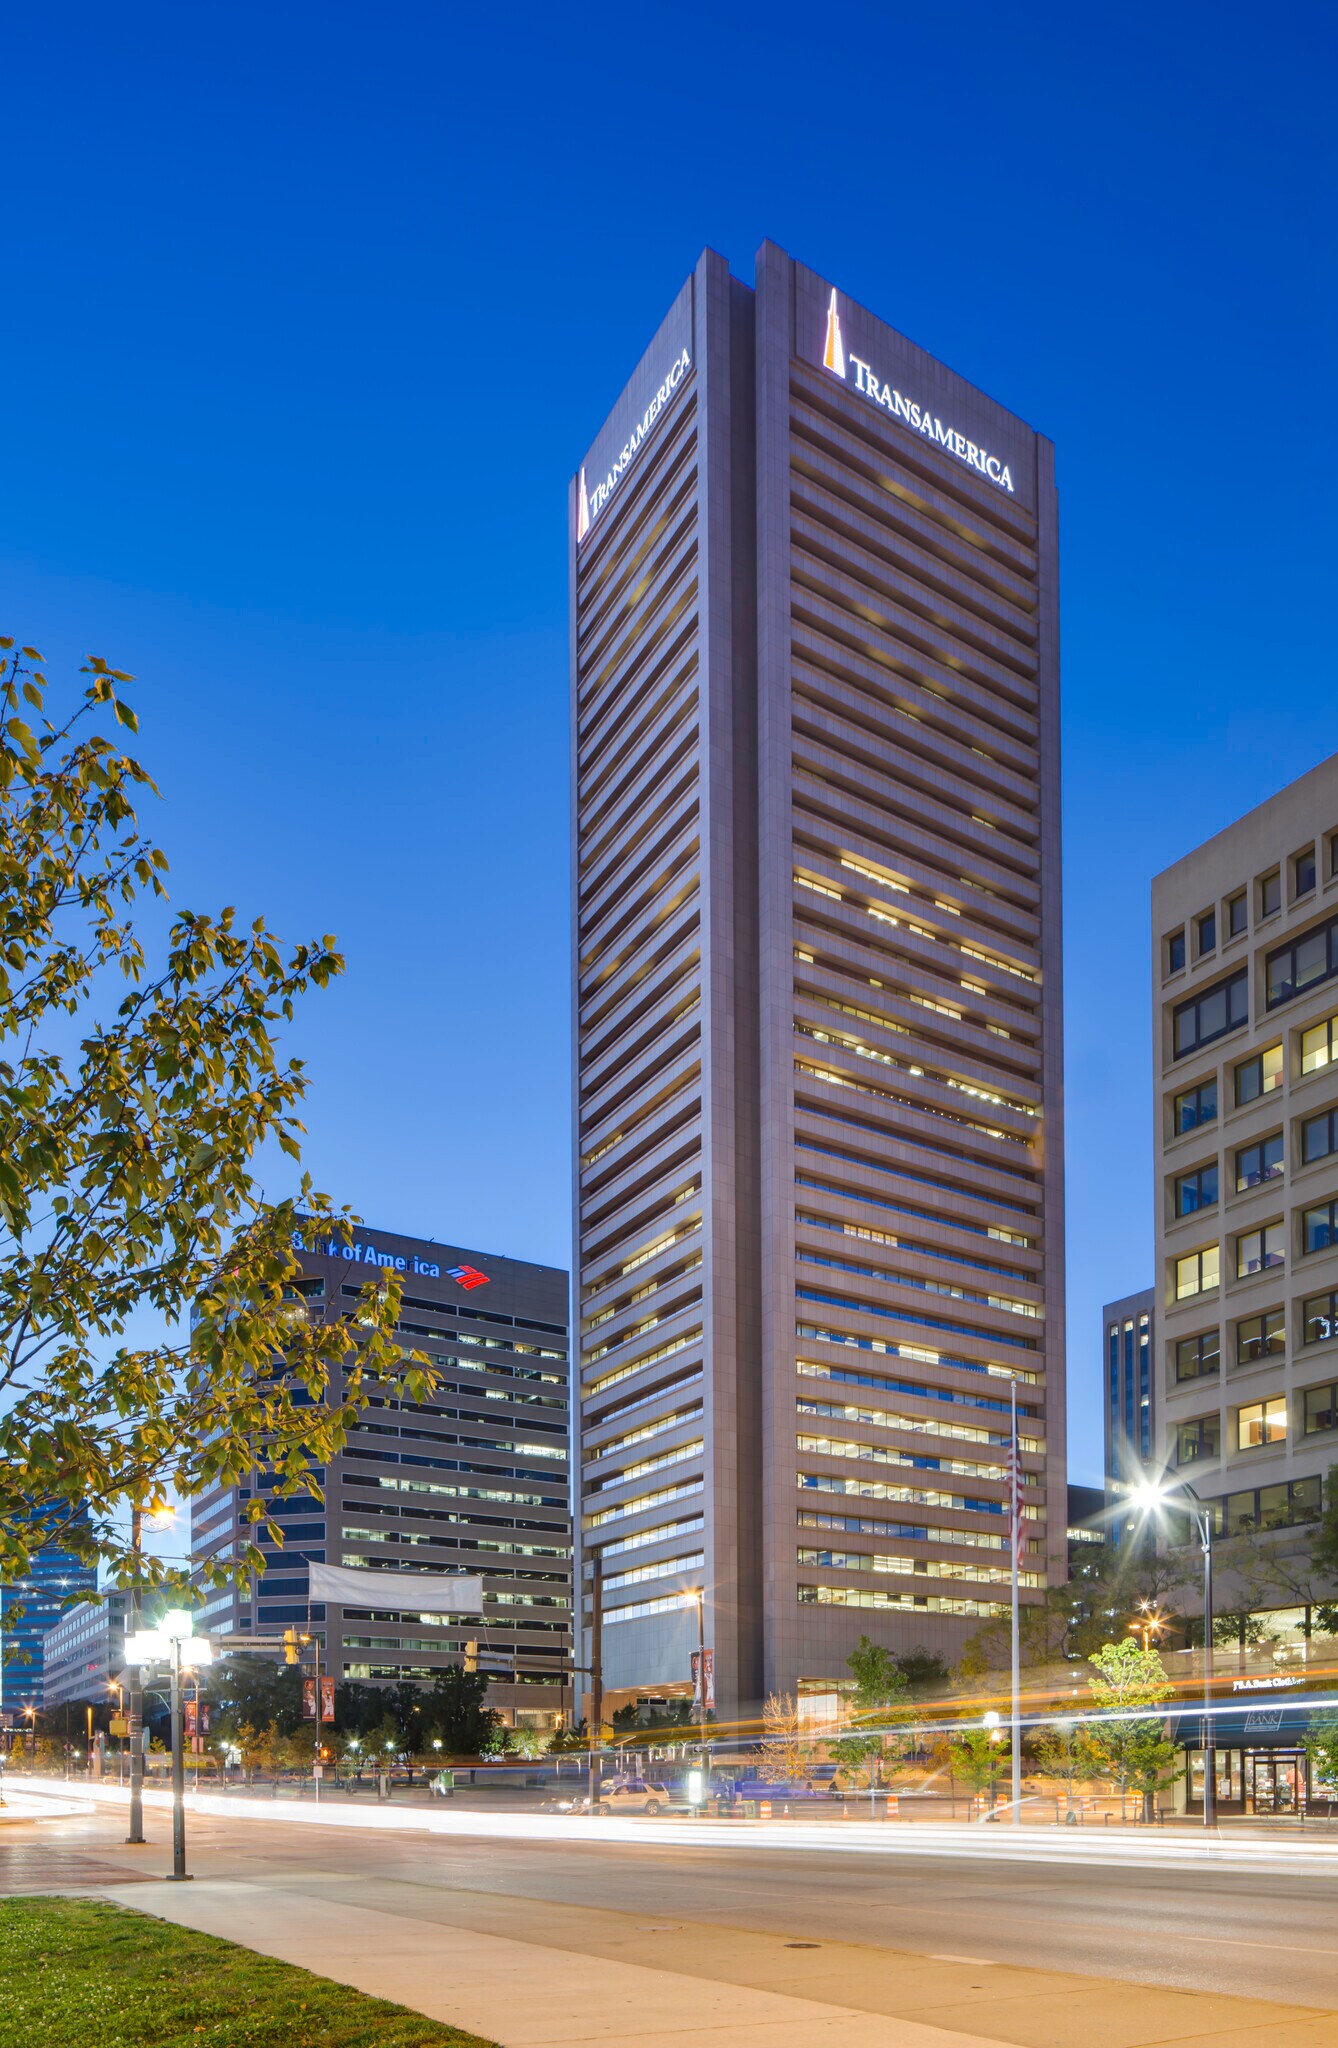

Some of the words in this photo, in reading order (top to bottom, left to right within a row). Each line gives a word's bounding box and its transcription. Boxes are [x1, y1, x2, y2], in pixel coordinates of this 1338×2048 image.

[590, 348, 690, 518] TRANSAMERICA
[849, 353, 1014, 492] TRANSAMERICA
[342, 1243, 362, 1262] of
[363, 1245, 440, 1278] America
[1248, 1714, 1278, 1725] BANK
